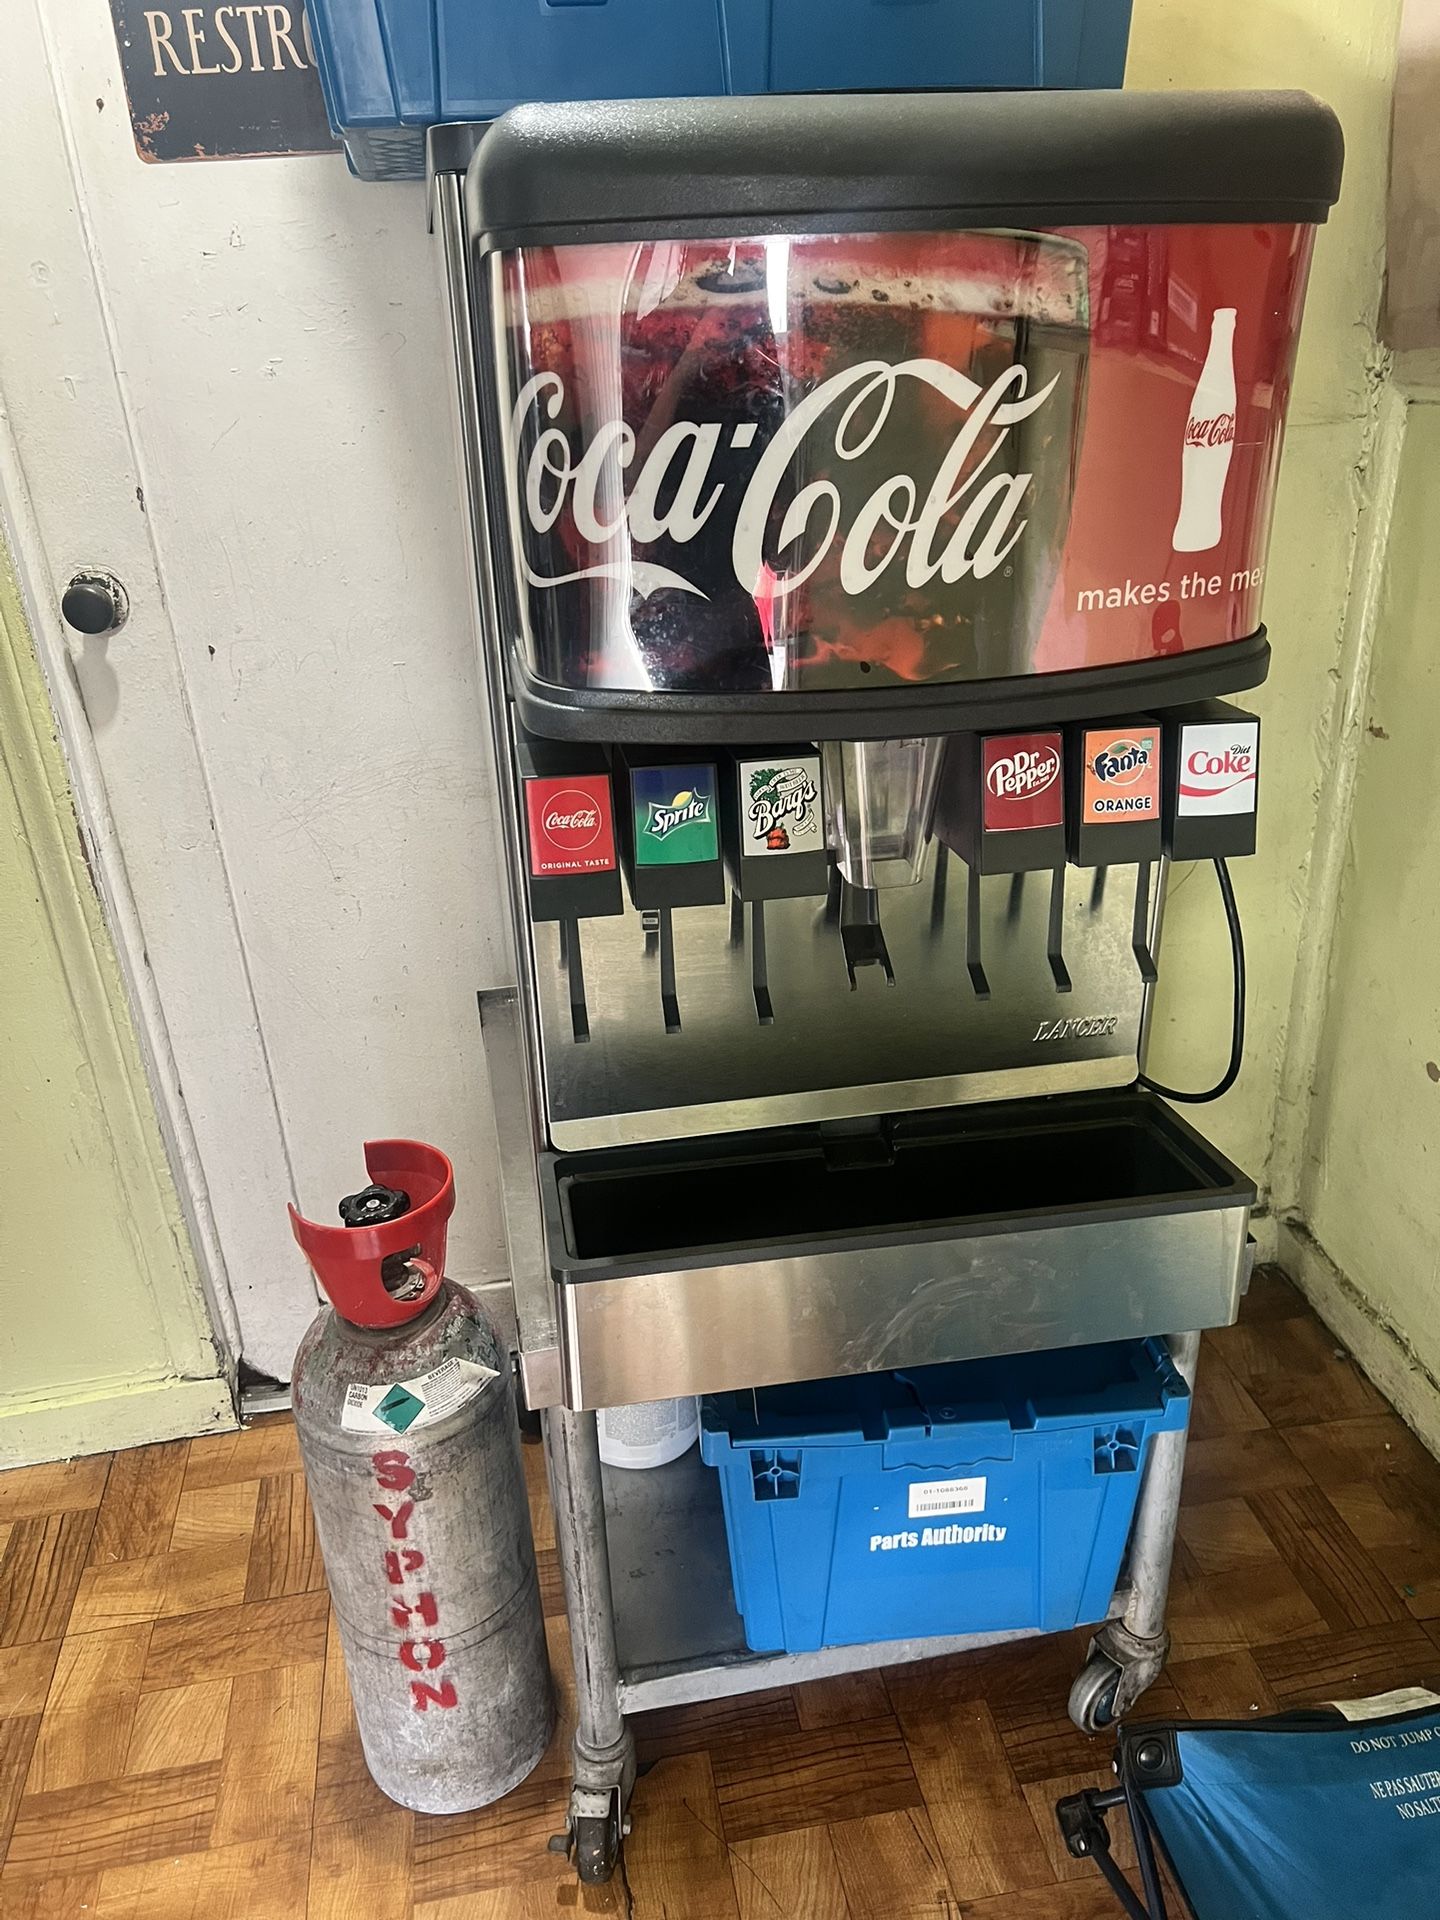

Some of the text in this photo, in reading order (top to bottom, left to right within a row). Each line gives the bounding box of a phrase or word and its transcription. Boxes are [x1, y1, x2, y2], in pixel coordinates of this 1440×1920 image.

[1185, 413, 1234, 447] Coca-Cola
[511, 359, 1061, 600] Coca-Cola
[1077, 579, 1170, 611] makes
[1181, 572, 1221, 599] the
[1230, 744, 1251, 755] Diet
[1013, 751, 1040, 775] Dr
[1094, 746, 1148, 781] Fanta
[1187, 751, 1251, 775] Coke
[987, 758, 1055, 797] Pepper
[651, 800, 704, 834] Sprite
[748, 780, 818, 840] Barq's
[1094, 797, 1151, 811] ORANGE
[546, 809, 597, 829] Coca-Cola
[541, 858, 610, 870] ORIGINAL TASTE
[1032, 1016, 1118, 1041] LANCER
[870, 1524, 1007, 1551] Parts Authority
[372, 1450, 458, 1711] SYPHON
[1350, 1741, 1371, 1754] DO
[1370, 1735, 1398, 1751] NOT
[1398, 1728, 1432, 1747] JUMP
[1370, 1782, 1386, 1799] NE
[1384, 1778, 1406, 1797] PAS
[1396, 1802, 1416, 1819] NO
